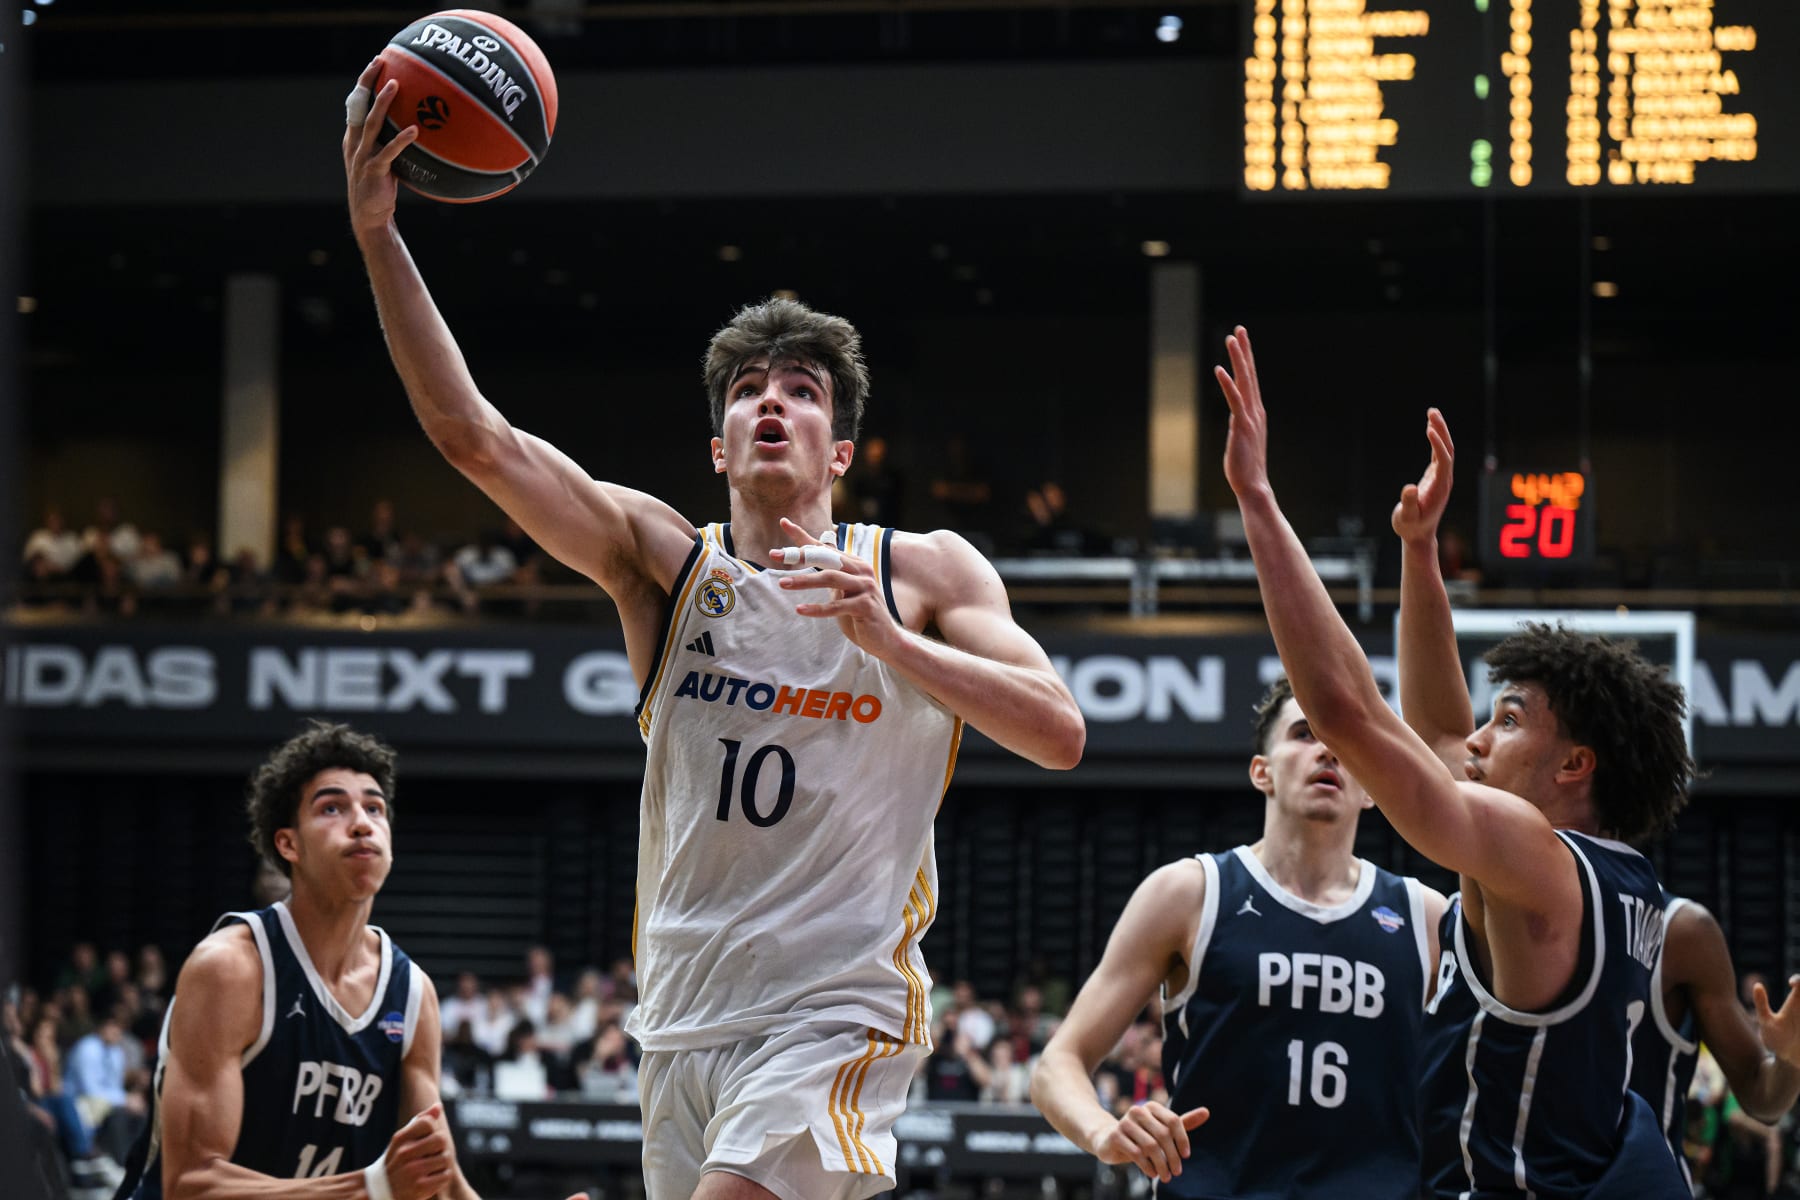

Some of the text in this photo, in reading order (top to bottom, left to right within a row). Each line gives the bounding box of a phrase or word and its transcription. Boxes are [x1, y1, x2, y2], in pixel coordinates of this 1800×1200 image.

[410, 23, 527, 117] SPALDING
[1500, 504, 1576, 558] 20
[249, 647, 533, 712] NEXT
[674, 671, 882, 724] AUTOHERO
[716, 738, 796, 828] 10
[1258, 952, 1385, 1019] PFBB
[292, 1060, 383, 1127] PFBB
[1287, 1039, 1349, 1108] 16
